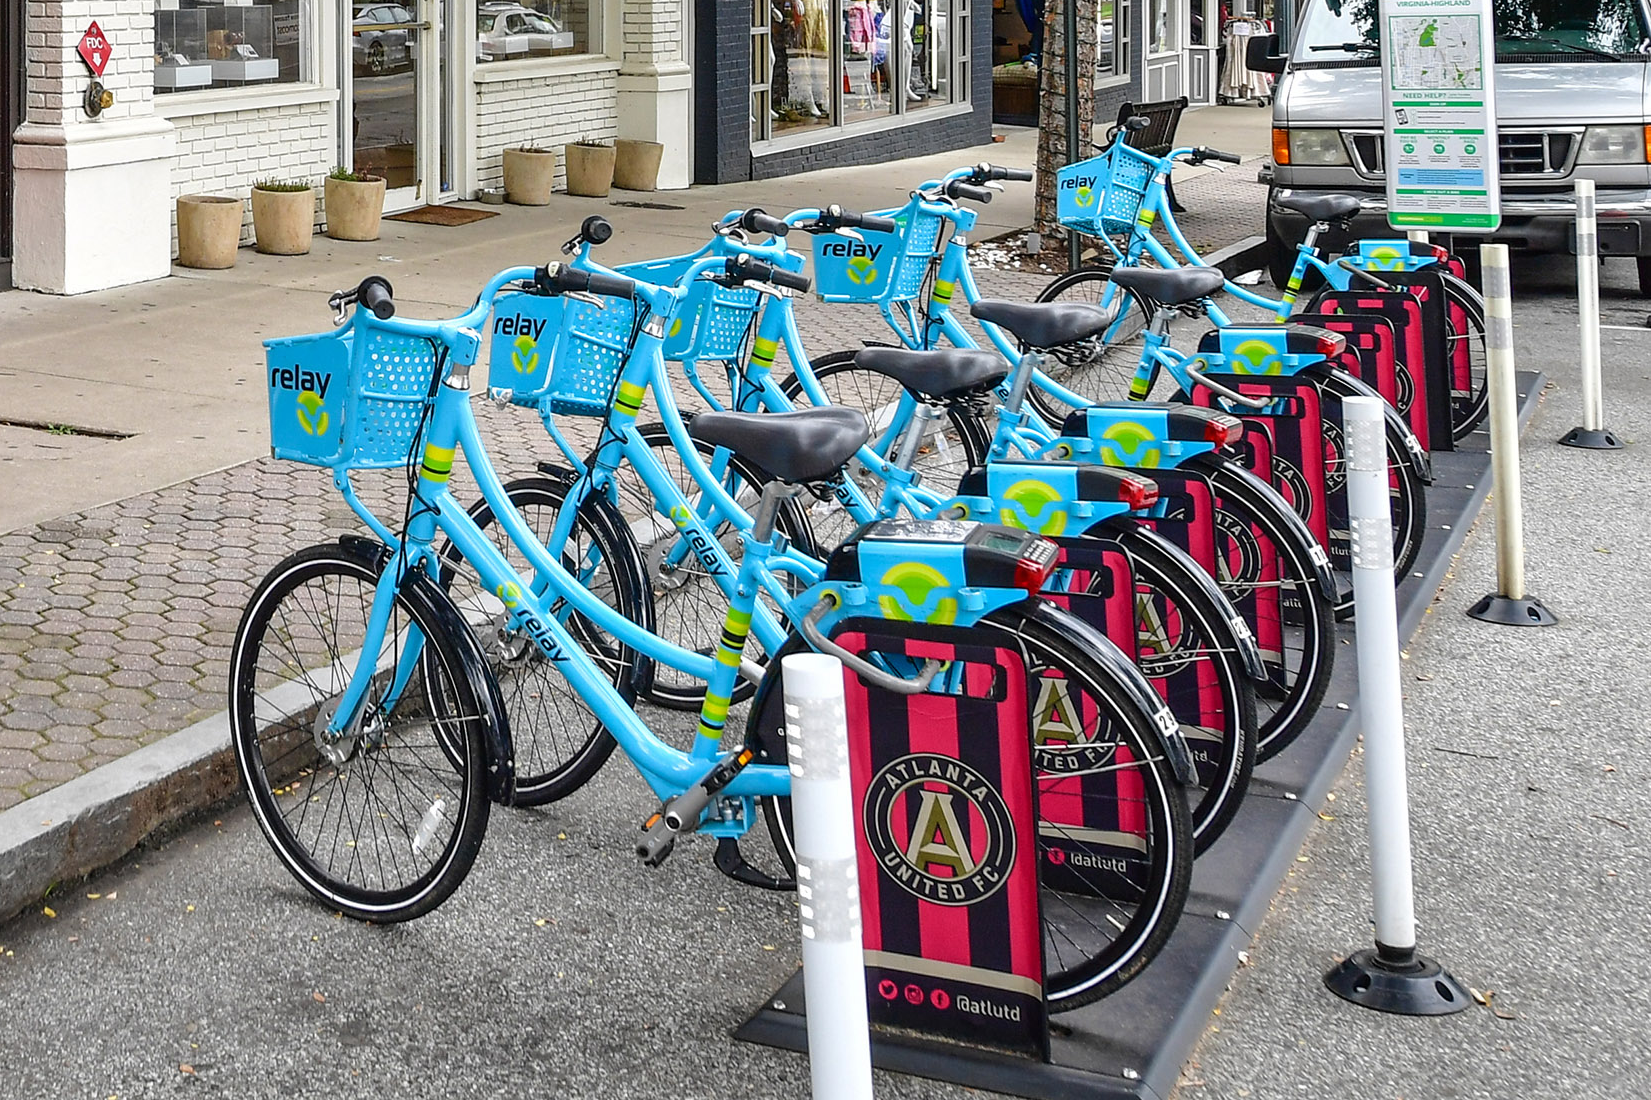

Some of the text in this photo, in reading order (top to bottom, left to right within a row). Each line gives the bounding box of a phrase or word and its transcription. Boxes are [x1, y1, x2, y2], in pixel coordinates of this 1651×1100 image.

[1396, 0, 1471, 8] VIRGINIA-HIGHLAND
[86, 37, 104, 49] FDC
[1060, 175, 1098, 190] relay
[822, 240, 883, 262] relay
[494, 312, 547, 342] relay
[271, 364, 331, 400] relay
[684, 528, 729, 578] relay
[516, 607, 572, 663] relay
[884, 761, 990, 803] ATLANTA
[883, 853, 1000, 901] UNITED FC
[955, 994, 1021, 1023] @atlutd
